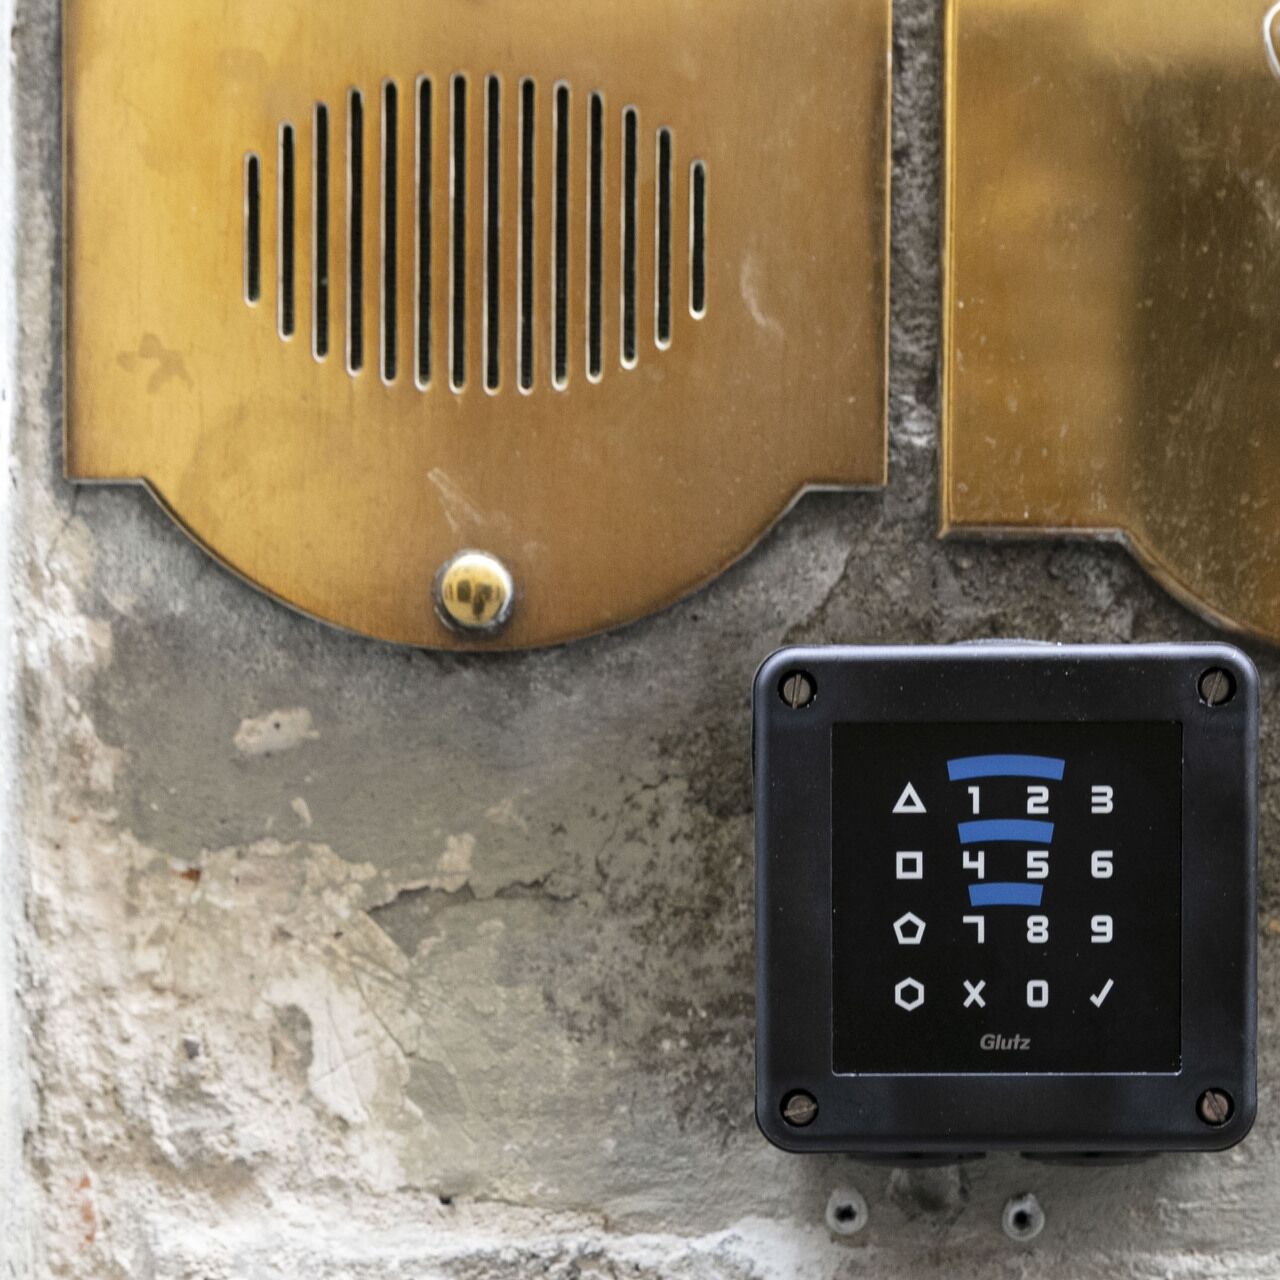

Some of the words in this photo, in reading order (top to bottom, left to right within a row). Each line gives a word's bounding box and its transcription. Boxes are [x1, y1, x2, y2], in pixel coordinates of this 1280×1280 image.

[967, 785, 980, 815] 1
[1026, 785, 1050, 814] 2
[1091, 785, 1114, 814] 3
[962, 850, 985, 879] 4
[1026, 850, 1049, 879] 5
[1090, 850, 1114, 879] 6
[962, 915, 985, 944] 7
[1026, 915, 1049, 944] 8
[1090, 914, 1114, 943] 9
[1026, 979, 1049, 1008] 0
[979, 1033, 1031, 1051] Glutz
